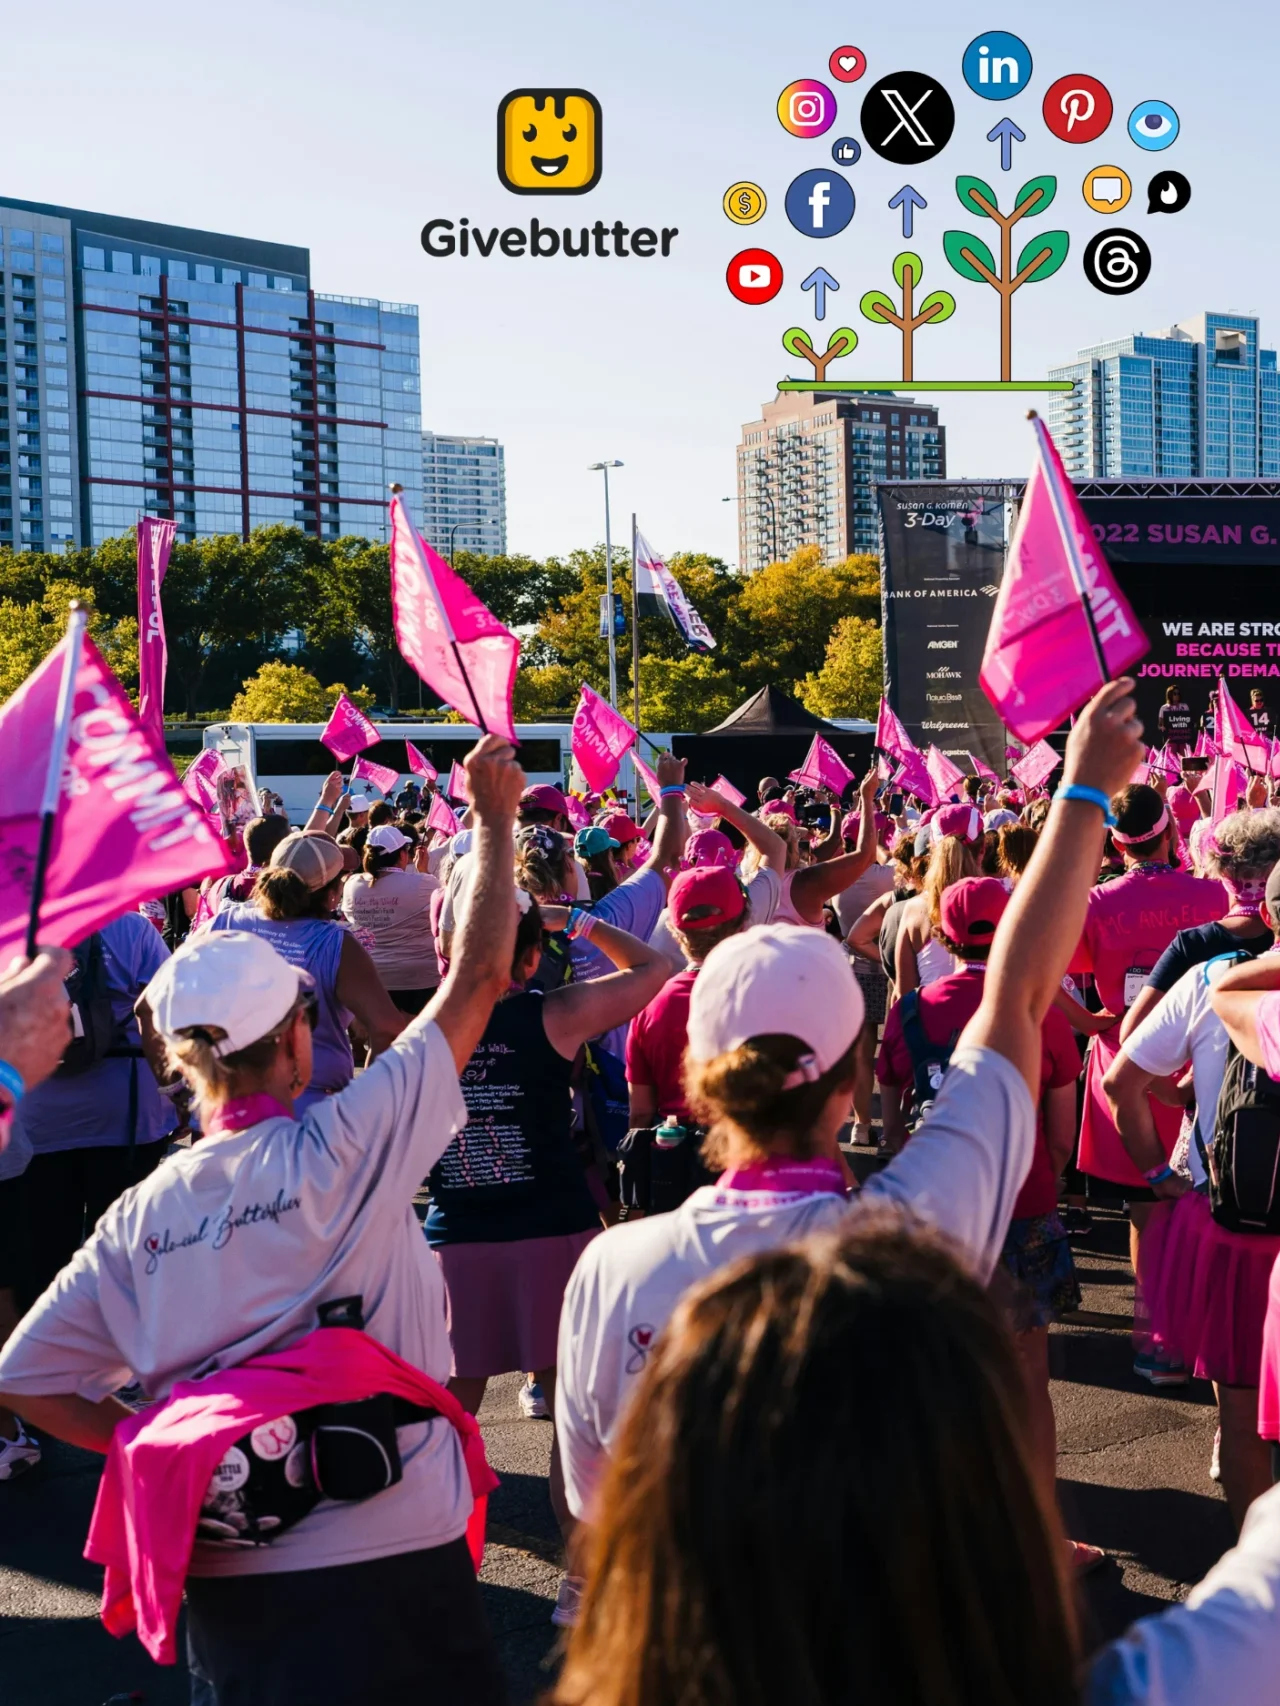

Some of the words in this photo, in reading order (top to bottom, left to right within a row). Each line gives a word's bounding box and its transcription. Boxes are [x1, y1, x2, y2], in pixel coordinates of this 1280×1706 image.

[904, 512, 956, 528] 3-Day
[1094, 523, 1140, 543] 022
[1147, 524, 1242, 544] SUSAN
[1250, 525, 1277, 545] G.
[914, 589, 928, 599] OF
[929, 589, 978, 599] AMERICA
[1162, 622, 1194, 637] WE
[1198, 622, 1235, 637] ARE
[927, 640, 958, 649] AMGEN
[1176, 643, 1261, 657] BECAUSE
[925, 671, 962, 679] MOHAWK
[1137, 664, 1224, 678] JOURNEY
[340, 701, 377, 738] COMMIT
[1168, 715, 1191, 723] Living
[1251, 712, 1270, 726] 14
[921, 721, 970, 732] Walgreens
[574, 712, 615, 764] OMMIT
[940, 749, 970, 757] ogistics
[1139, 904, 1205, 930] ANGEL
